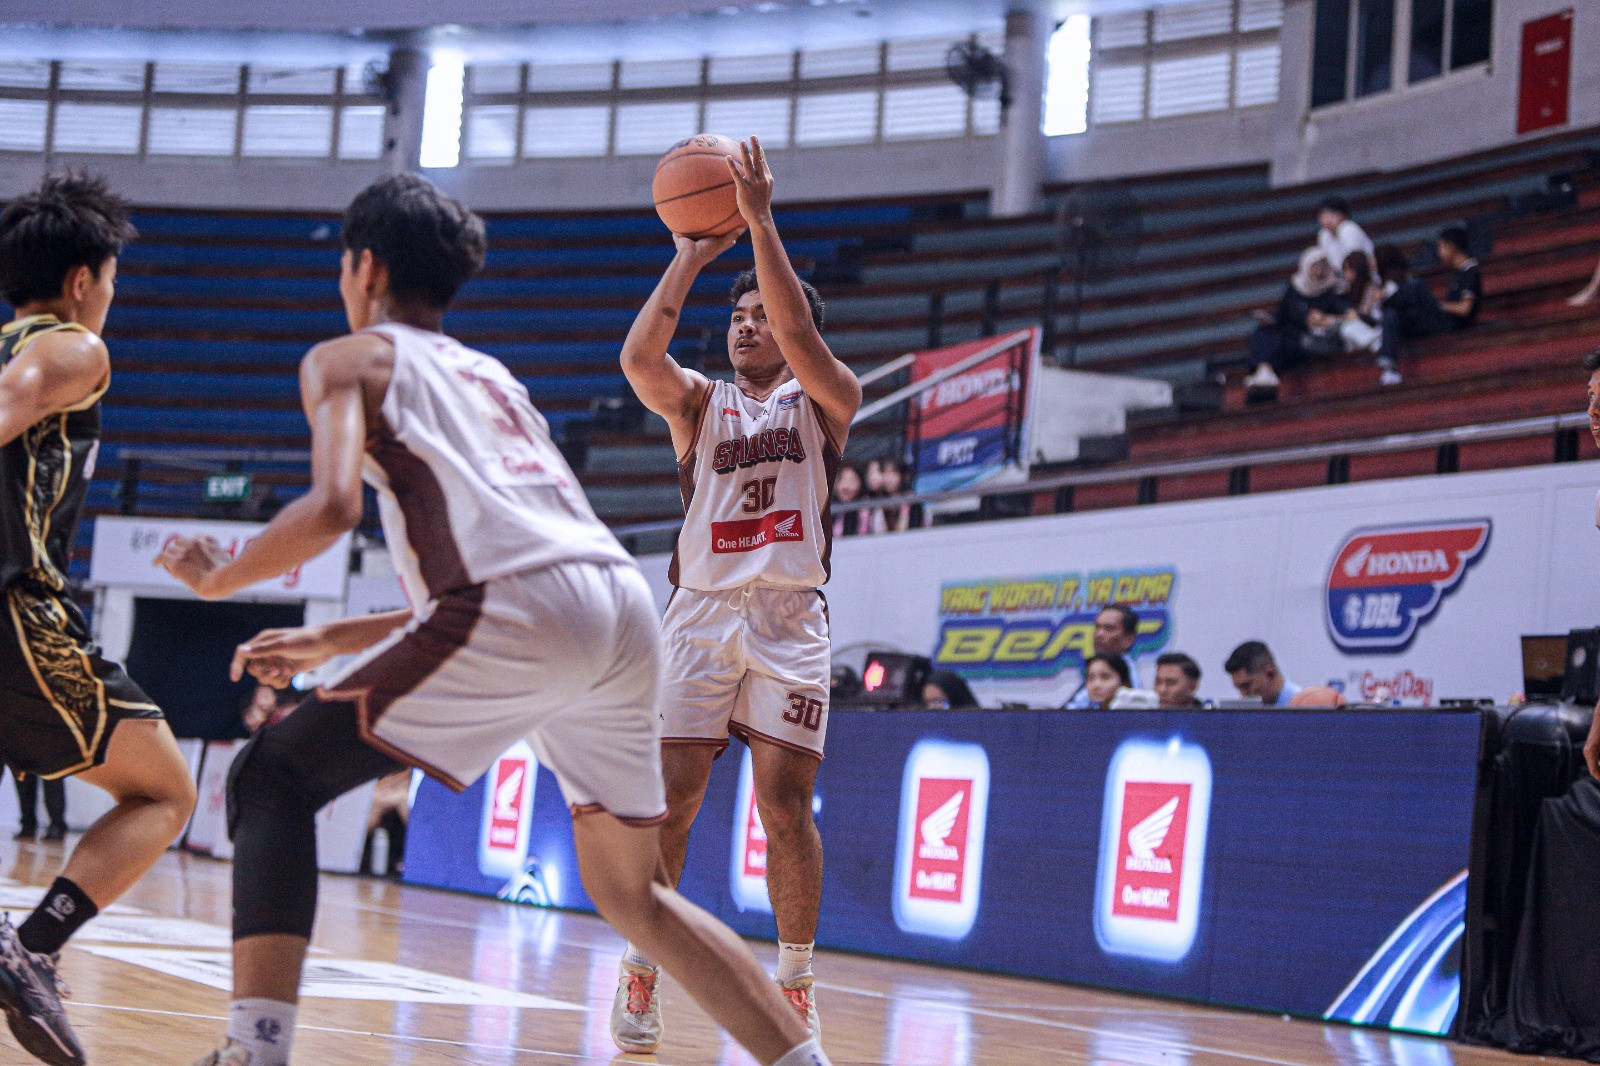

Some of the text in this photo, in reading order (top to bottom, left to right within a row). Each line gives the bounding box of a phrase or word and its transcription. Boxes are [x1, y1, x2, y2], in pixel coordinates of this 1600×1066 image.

[712, 427, 806, 475] SMANSA
[208, 483, 246, 497] EXIT
[741, 475, 778, 515] 30
[717, 538, 736, 549] One
[1367, 549, 1449, 576] HONDA
[941, 586, 989, 615] YANG
[989, 580, 1057, 614] WORTH
[1085, 577, 1115, 609] YA
[1114, 573, 1174, 606] CUMA
[1363, 594, 1402, 629] DBL
[782, 692, 822, 732] 30
[919, 844, 959, 861] HONDA
[1125, 856, 1172, 873] HONDA
[1122, 884, 1141, 906] One
